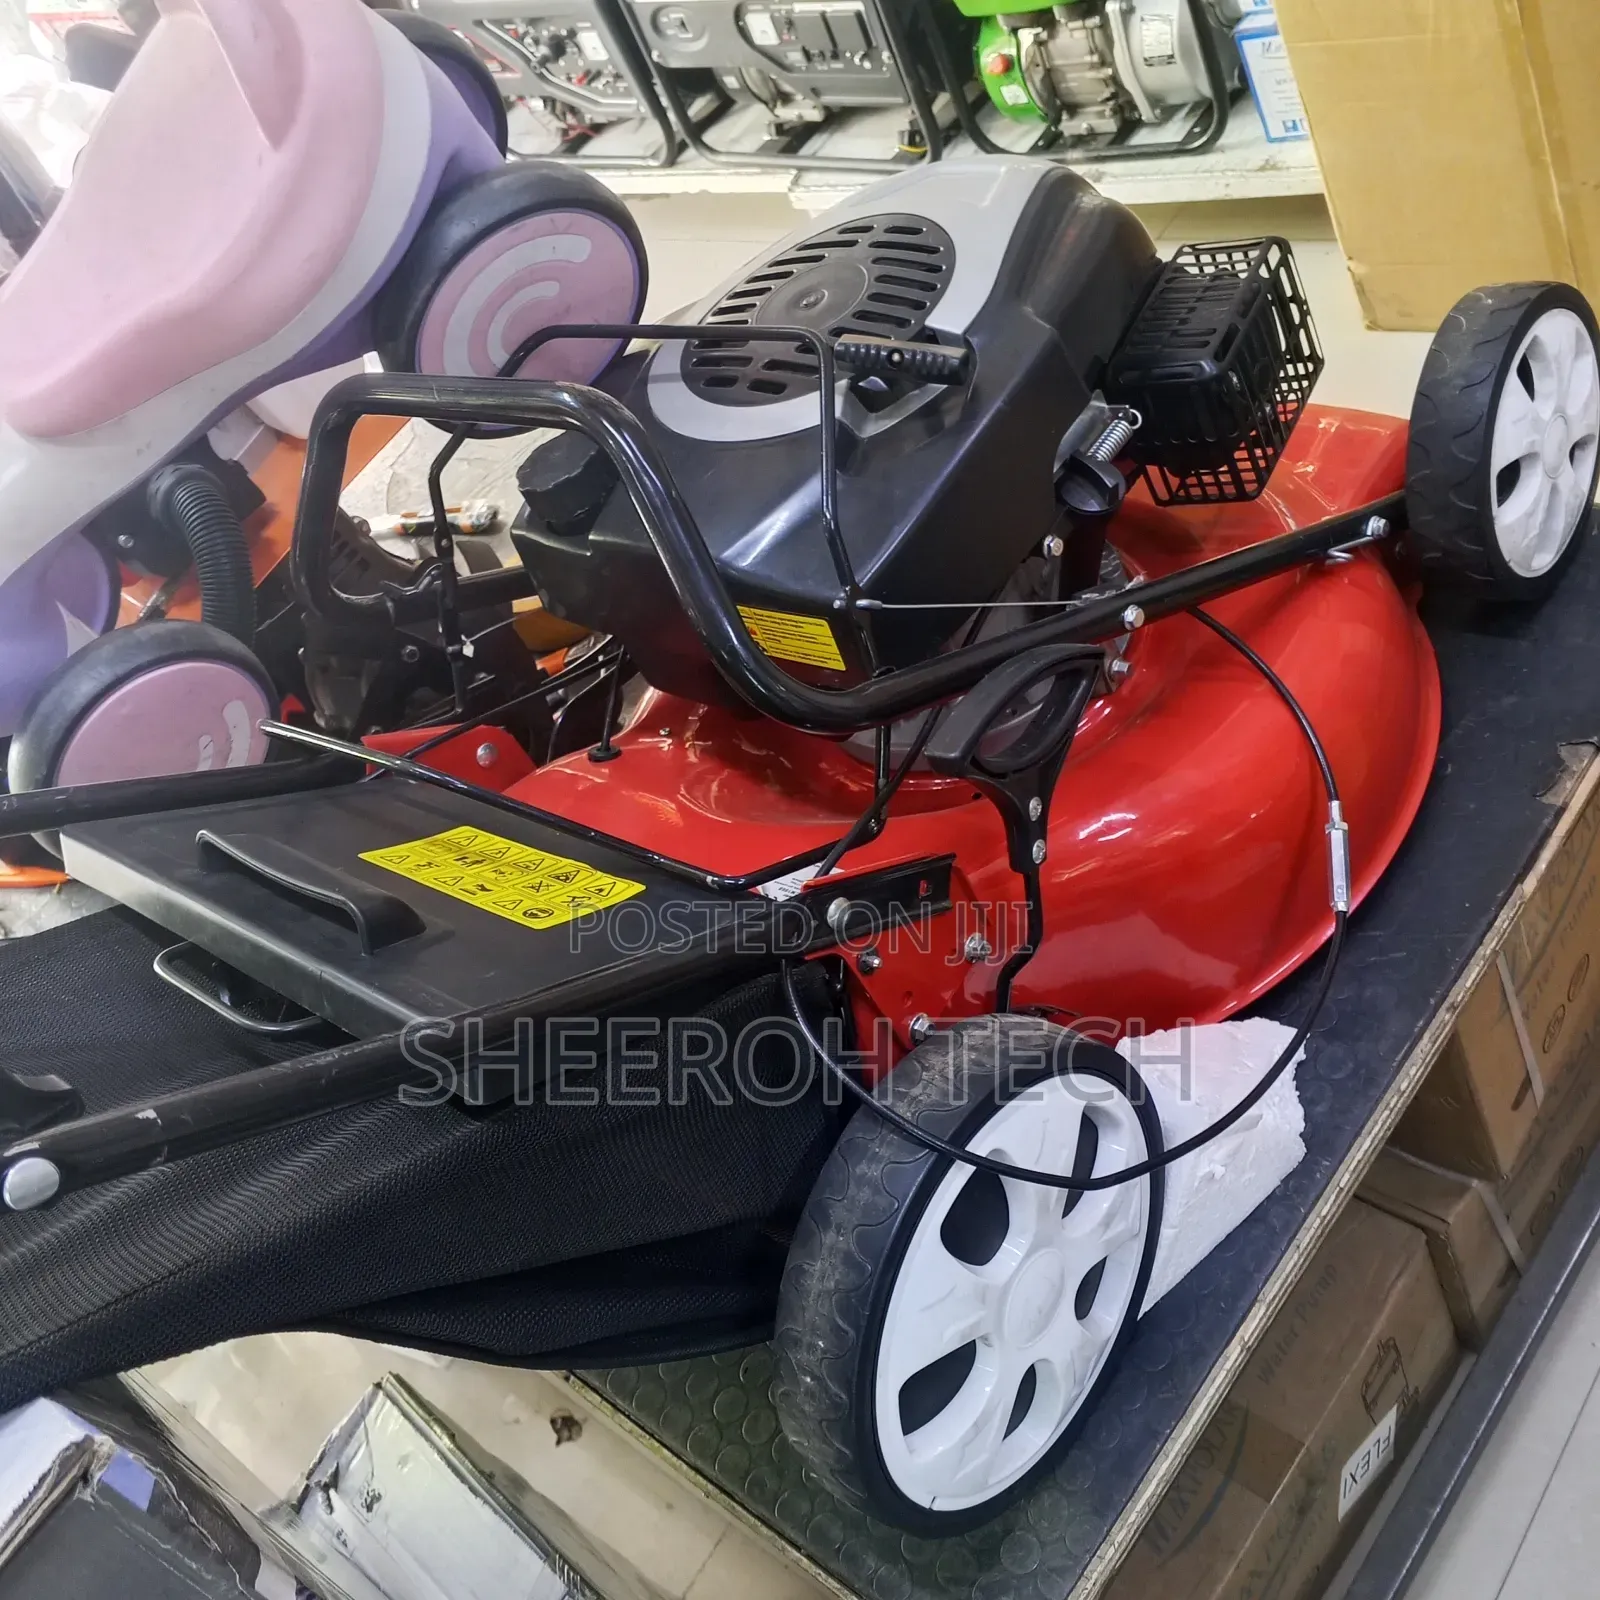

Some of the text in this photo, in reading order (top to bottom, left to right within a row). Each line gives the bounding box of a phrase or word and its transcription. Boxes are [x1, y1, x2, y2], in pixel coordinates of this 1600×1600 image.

[1256, 1324, 1299, 1385] Water
[1294, 1263, 1337, 1322] Pump
[1342, 1424, 1393, 1500] FLEXI
